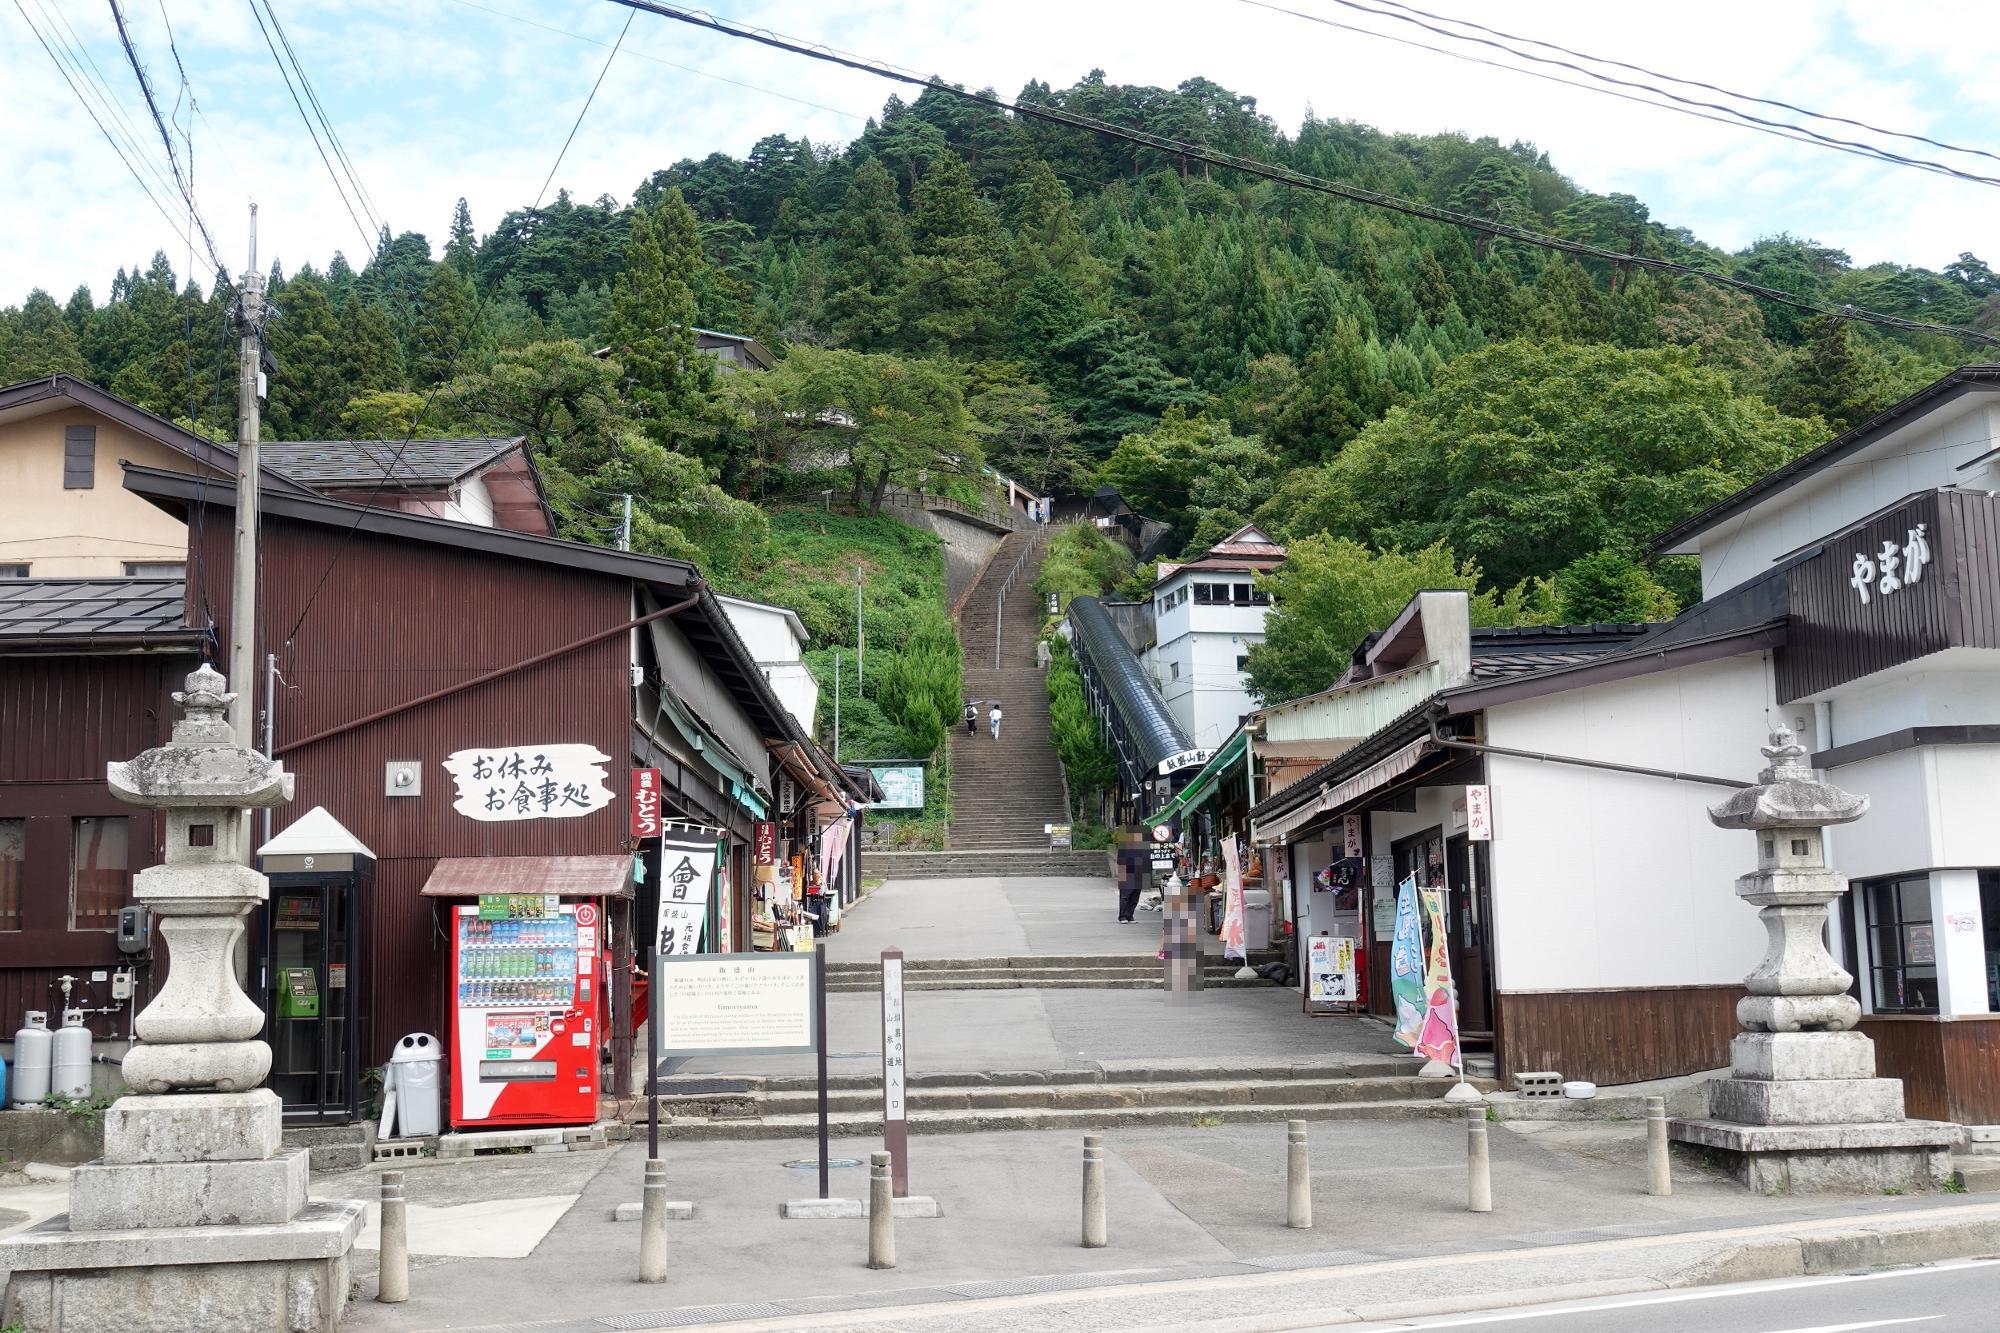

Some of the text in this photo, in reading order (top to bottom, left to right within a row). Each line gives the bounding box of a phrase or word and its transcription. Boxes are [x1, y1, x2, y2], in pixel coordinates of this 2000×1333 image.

[1849, 523, 1932, 605] やまが
[471, 752, 553, 779] お休み
[484, 780, 592, 814] お食事処
[635, 788, 657, 834] むとう
[783, 783, 791, 812] 大久保商店
[1470, 789, 1483, 828] やまが
[1346, 817, 1357, 848] やまが
[1275, 847, 1284, 873] やまが
[668, 855, 702, 901] 會
[890, 1078, 899, 1108] 入口
